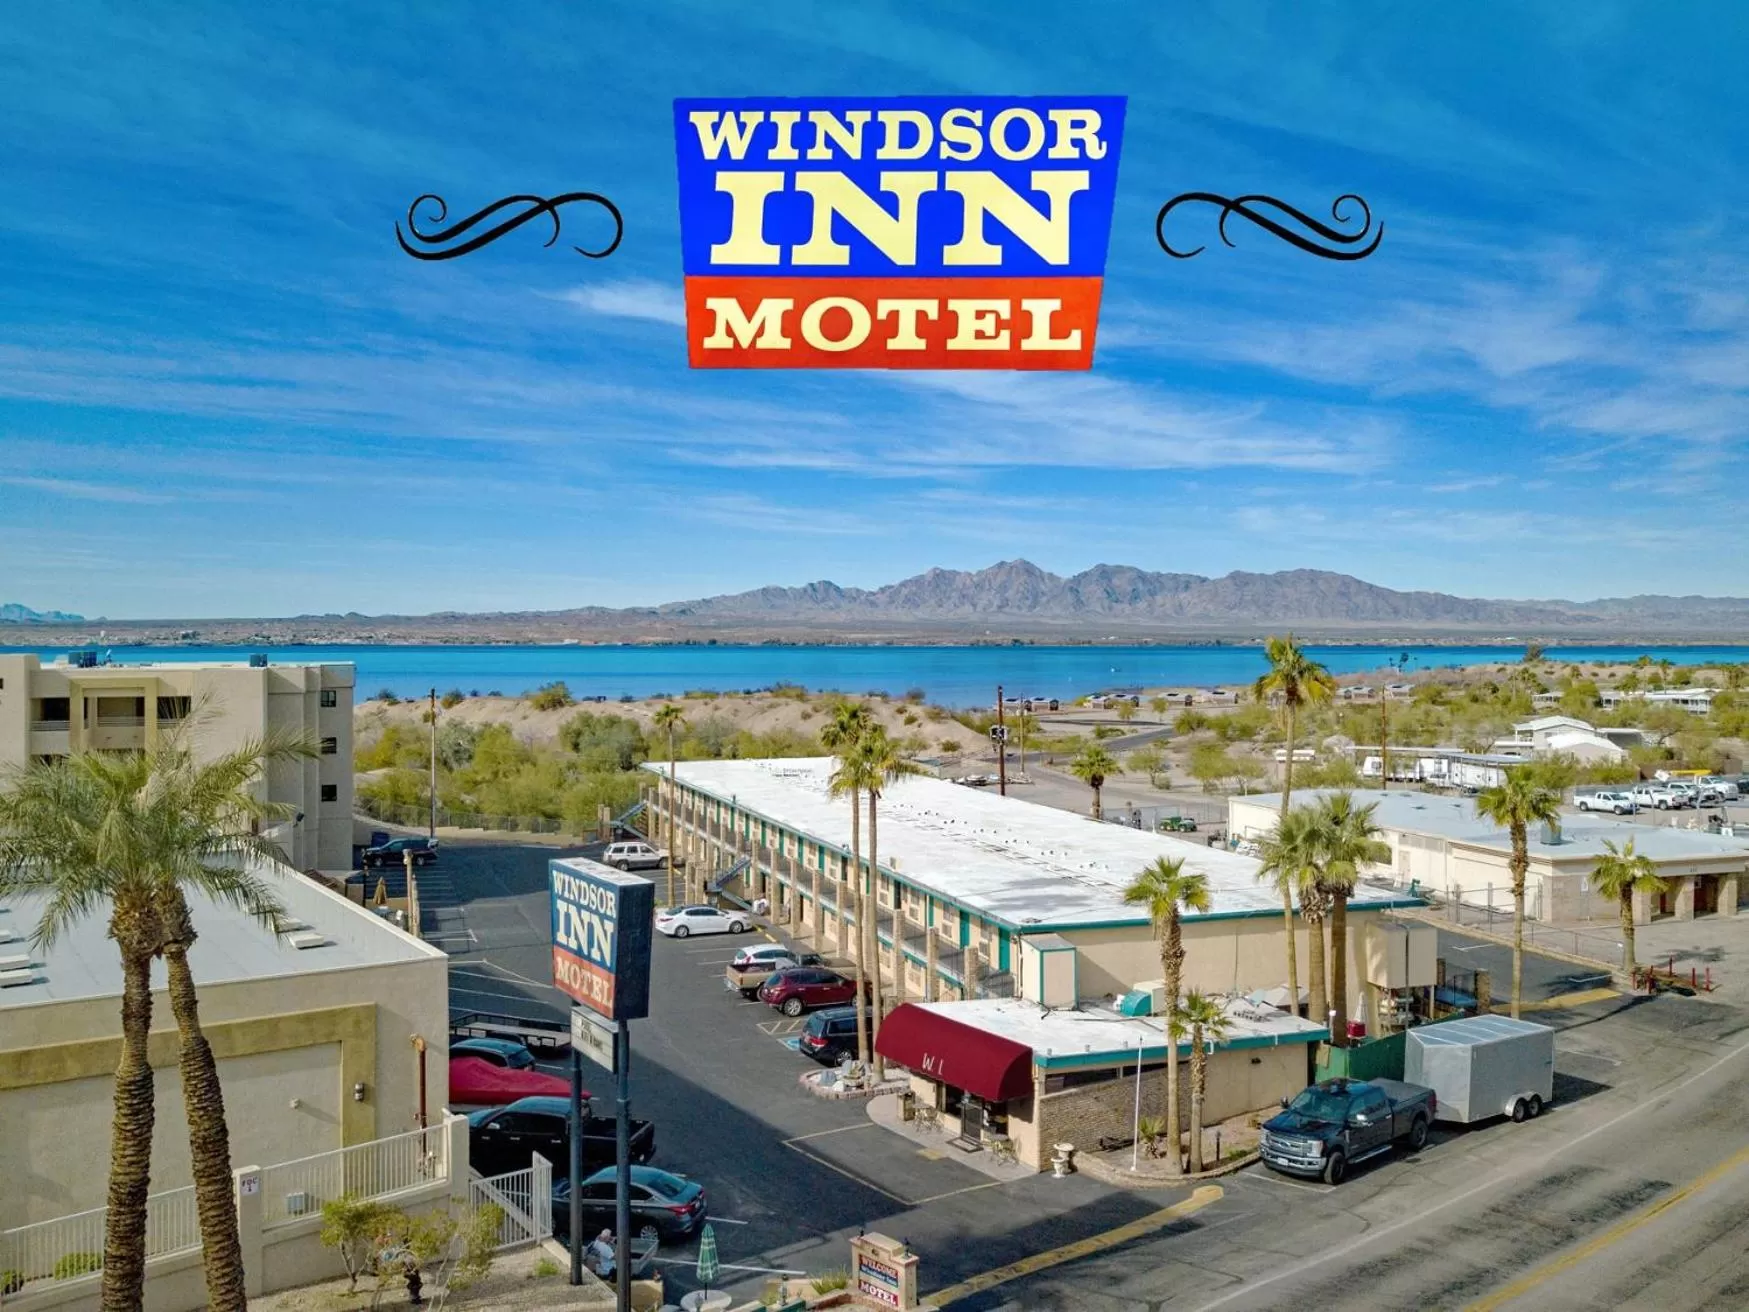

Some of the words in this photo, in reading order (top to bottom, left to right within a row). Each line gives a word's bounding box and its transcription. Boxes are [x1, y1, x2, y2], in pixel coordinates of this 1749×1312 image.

[552, 870, 616, 918] WINDSOR
[556, 901, 614, 967] INN
[556, 957, 613, 1008] MOTEL
[860, 1281, 897, 1304] MOTEL
